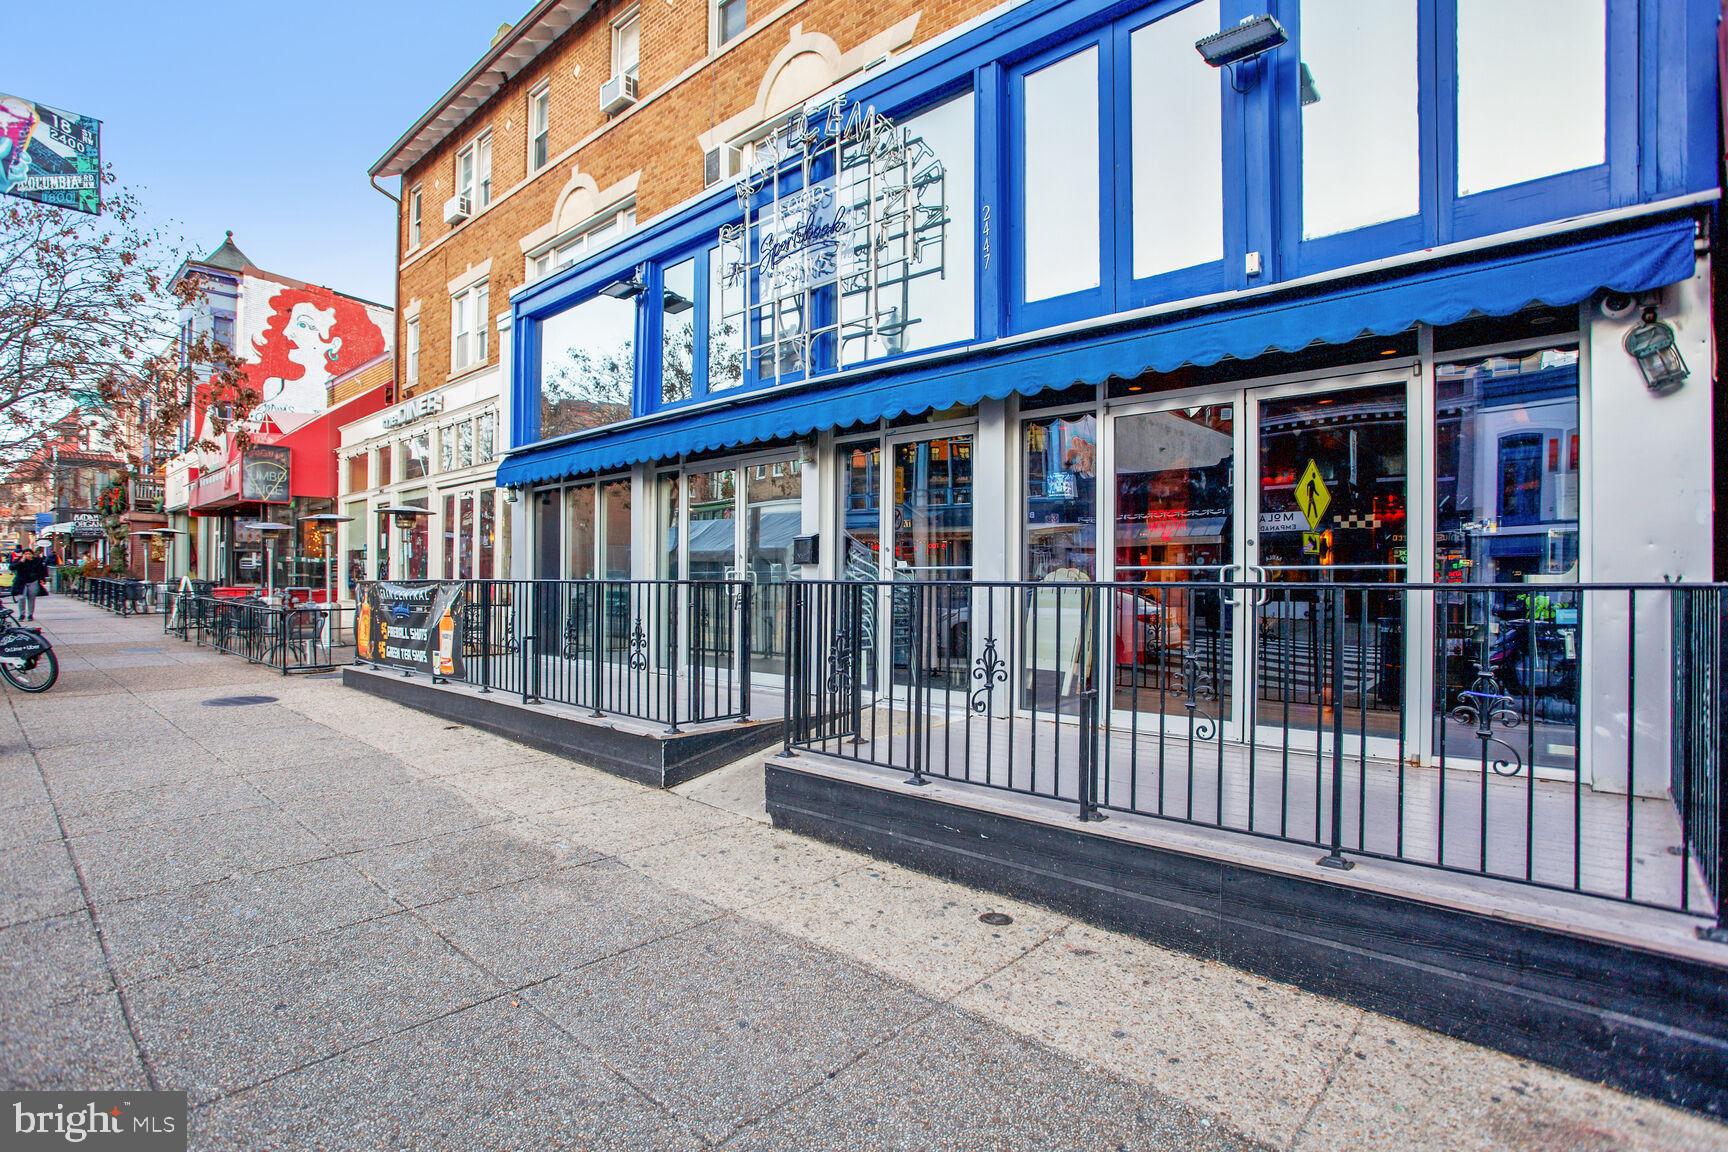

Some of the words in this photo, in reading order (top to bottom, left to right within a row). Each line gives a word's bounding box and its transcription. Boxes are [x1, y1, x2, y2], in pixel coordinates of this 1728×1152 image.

[51, 114, 72, 134] 18
[49, 129, 85, 153] 2400
[18, 175, 81, 190] COLUMBIA
[758, 205, 846, 275] Sportsbook
[982, 205, 991, 270] 2447
[410, 628, 427, 641] SHOTS
[401, 648, 413, 660] TEA
